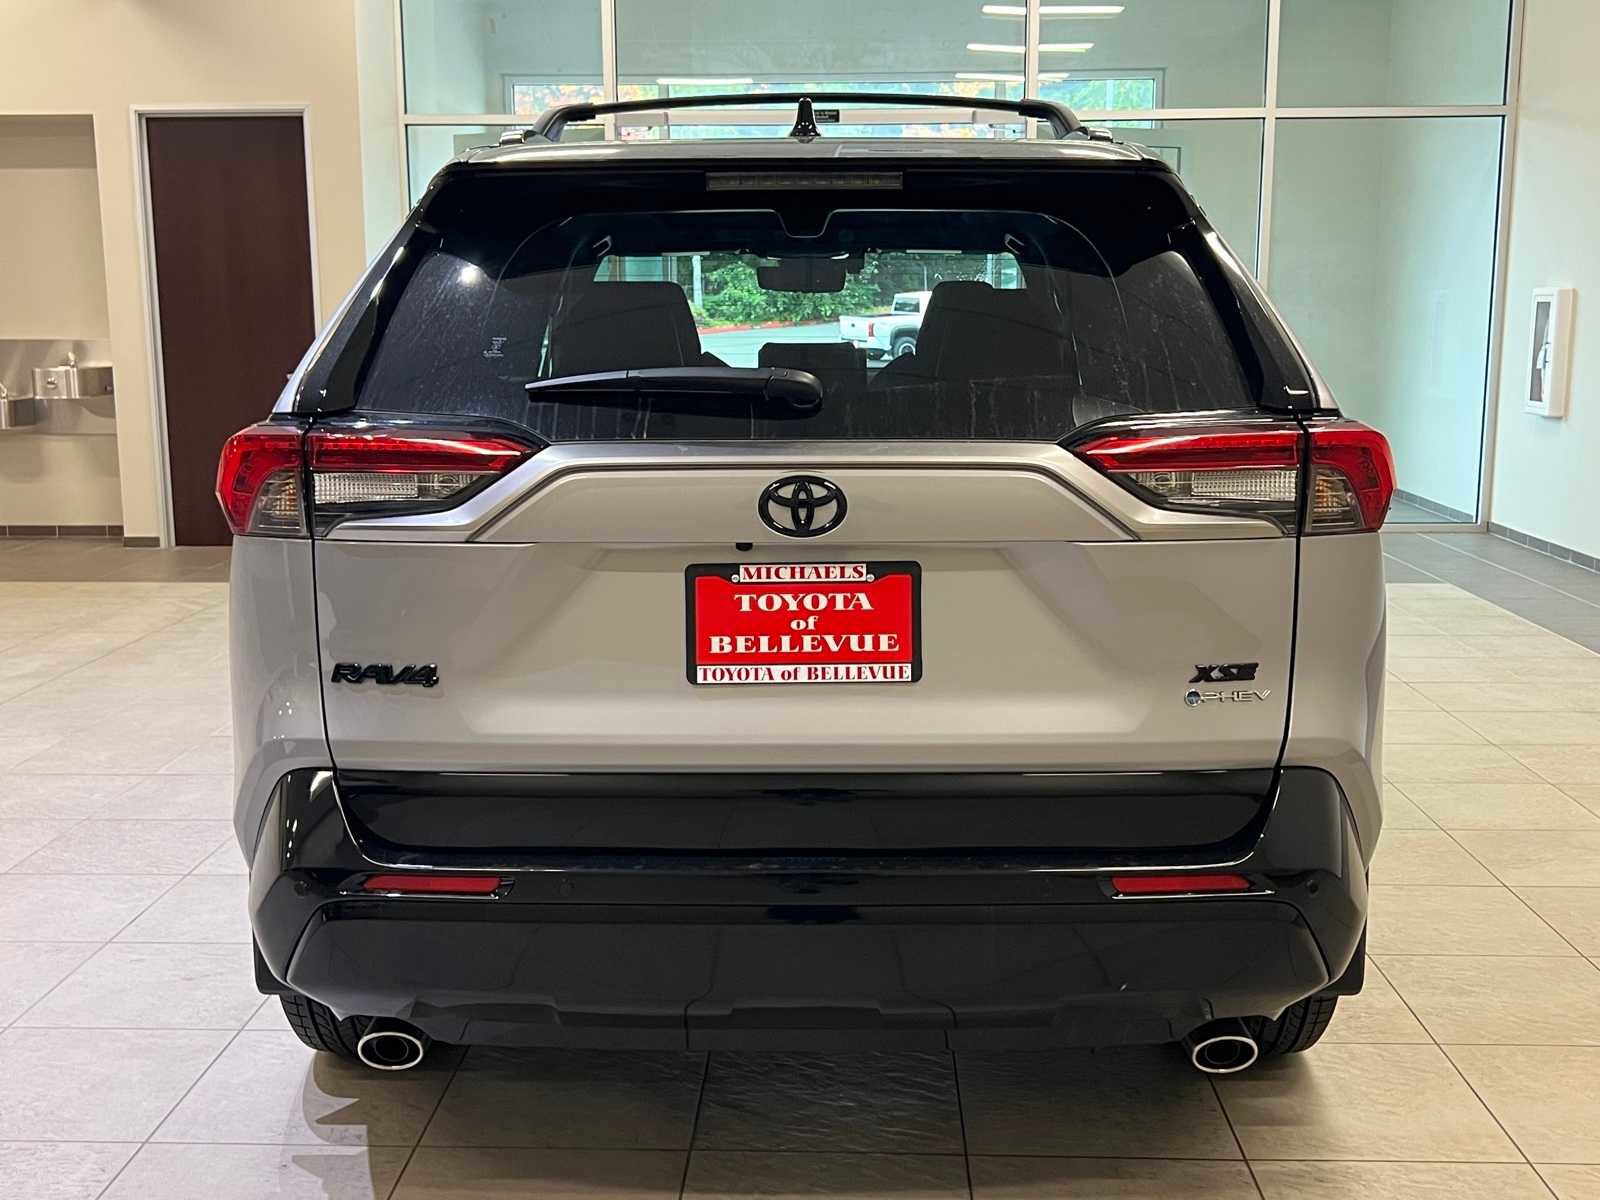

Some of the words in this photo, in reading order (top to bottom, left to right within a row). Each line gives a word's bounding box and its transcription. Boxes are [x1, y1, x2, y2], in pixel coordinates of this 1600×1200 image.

[742, 564, 865, 582] MICHAELS
[734, 592, 874, 612] TOYOTA
[790, 616, 818, 631] of
[709, 633, 900, 654] BELLEVUE
[330, 663, 439, 688] RAV4
[699, 667, 775, 682] TOYOTA
[780, 666, 801, 681] of
[807, 665, 911, 681] BELLEVUE
[1188, 662, 1259, 683] XSE
[1200, 688, 1271, 703] PHEV
